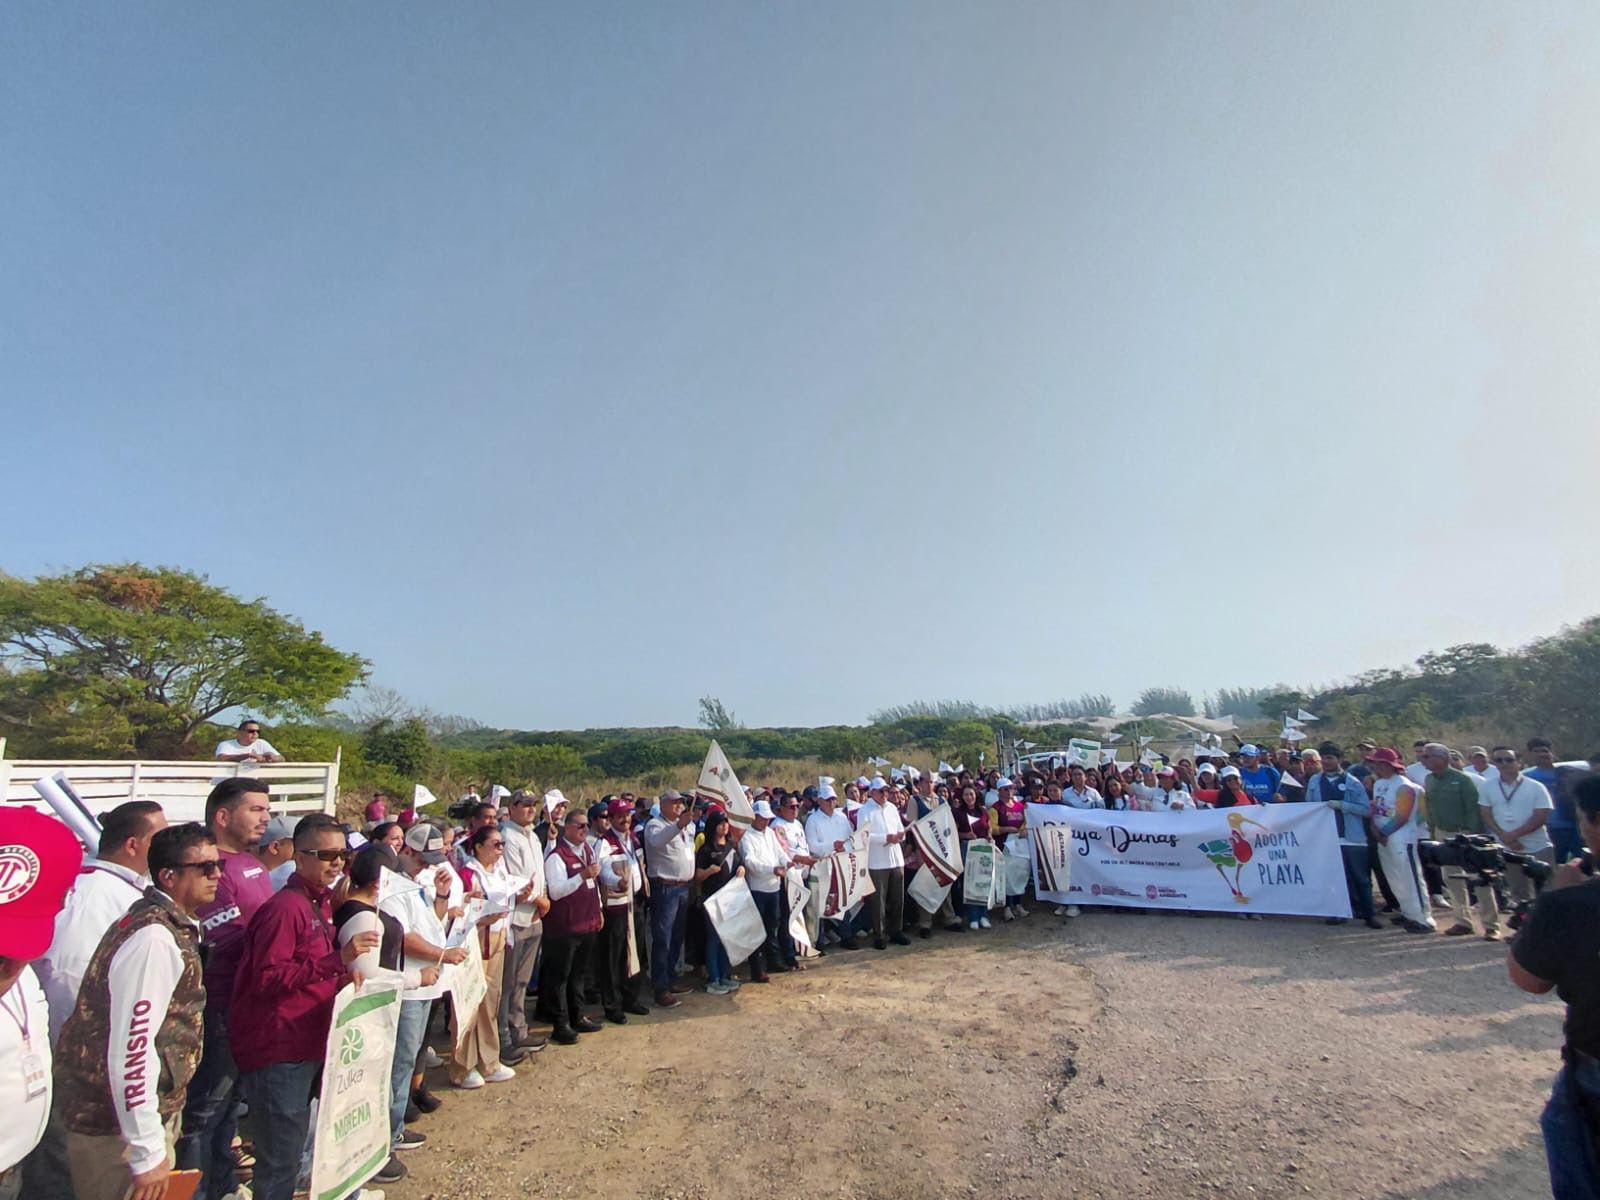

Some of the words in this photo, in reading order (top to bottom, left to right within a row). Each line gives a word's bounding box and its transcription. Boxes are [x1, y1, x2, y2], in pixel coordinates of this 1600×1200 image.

[927, 820, 949, 859] ALTAMIRA
[1106, 825, 1180, 853] Dunas
[1254, 831, 1300, 849] ADOPTA
[1268, 849, 1288, 861] UNA
[848, 852, 857, 896] ALTAMIRA
[1257, 862, 1305, 885] PLAYA
[124, 1000, 152, 1112] TRANSITO
[336, 1068, 364, 1095] Zulka
[334, 1102, 372, 1143] MORENA
